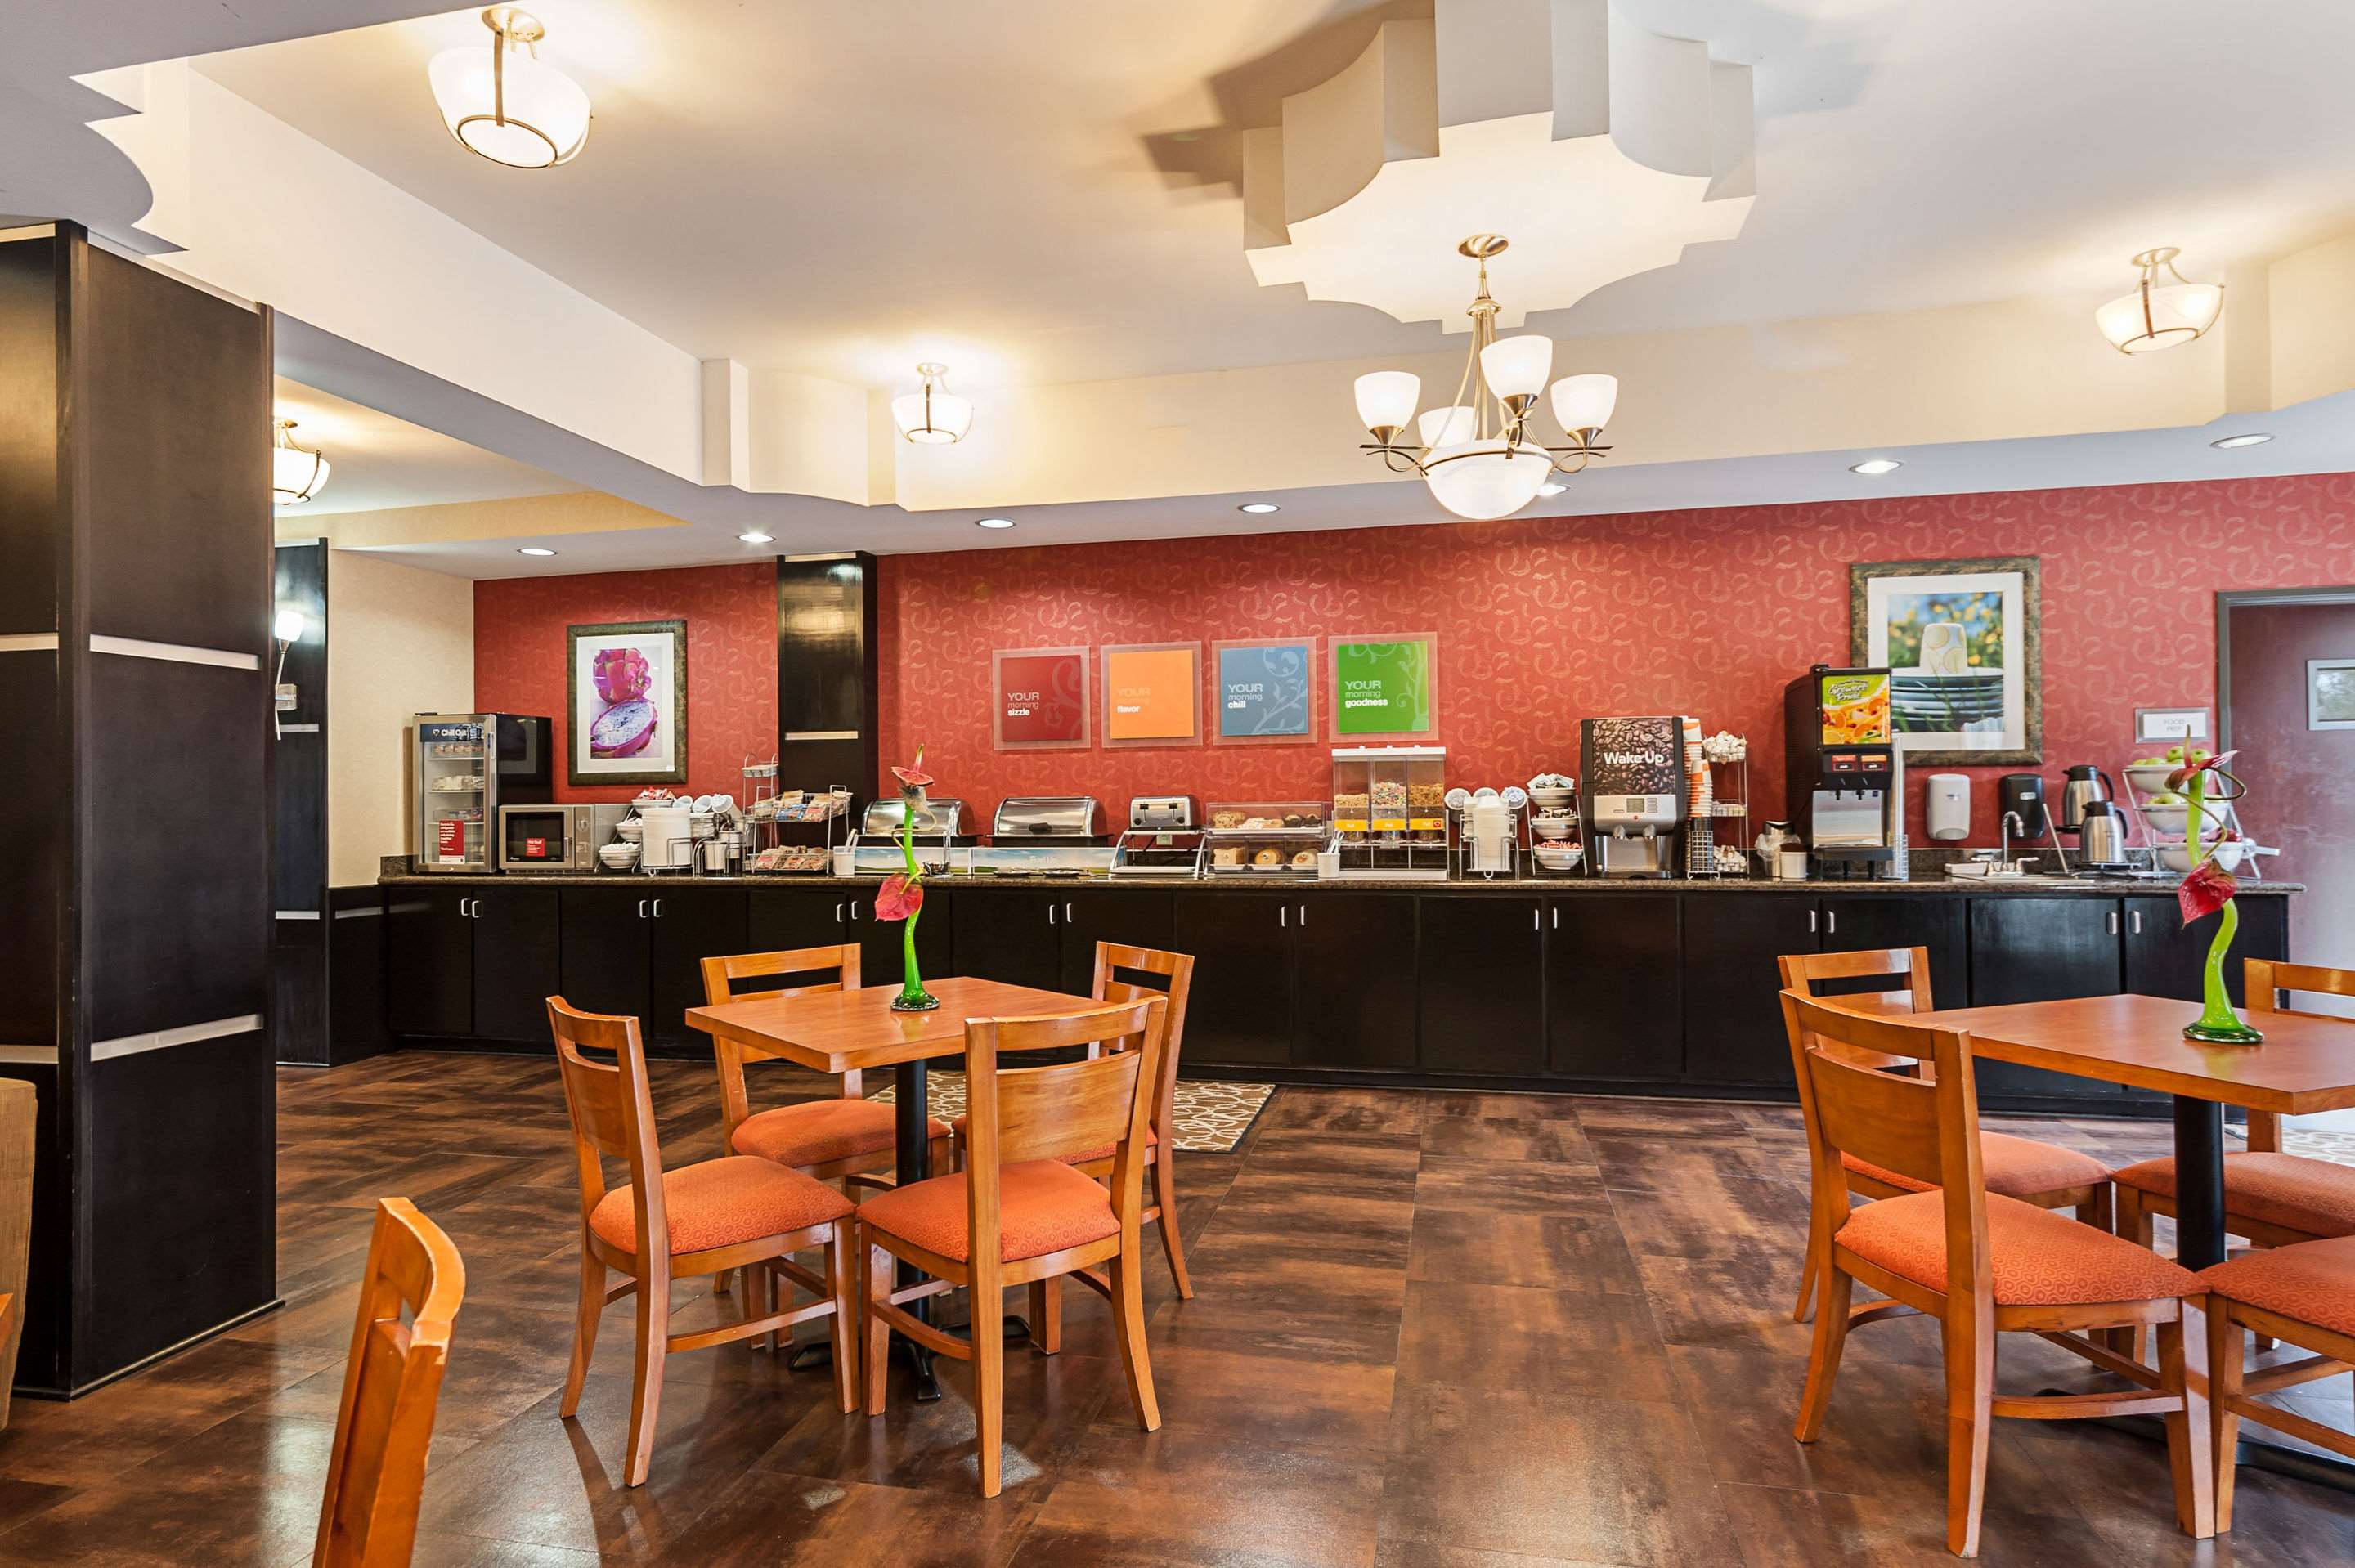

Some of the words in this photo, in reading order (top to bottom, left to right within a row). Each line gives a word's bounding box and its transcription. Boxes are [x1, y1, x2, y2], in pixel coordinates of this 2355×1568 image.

[1227, 683, 1263, 693] YOUR
[1344, 679, 1381, 690] YOUR
[1007, 692, 1039, 701] YOUR
[1228, 693, 1263, 702] morning
[1345, 690, 1381, 699] morning
[1007, 701, 1039, 710] morning
[1227, 701, 1246, 710] chill
[1345, 698, 1388, 709] goodness
[1007, 708, 1030, 717] sizzle
[1116, 705, 1141, 714] flavor
[1603, 751, 1642, 764] Wake
[1644, 750, 1665, 766] Up
